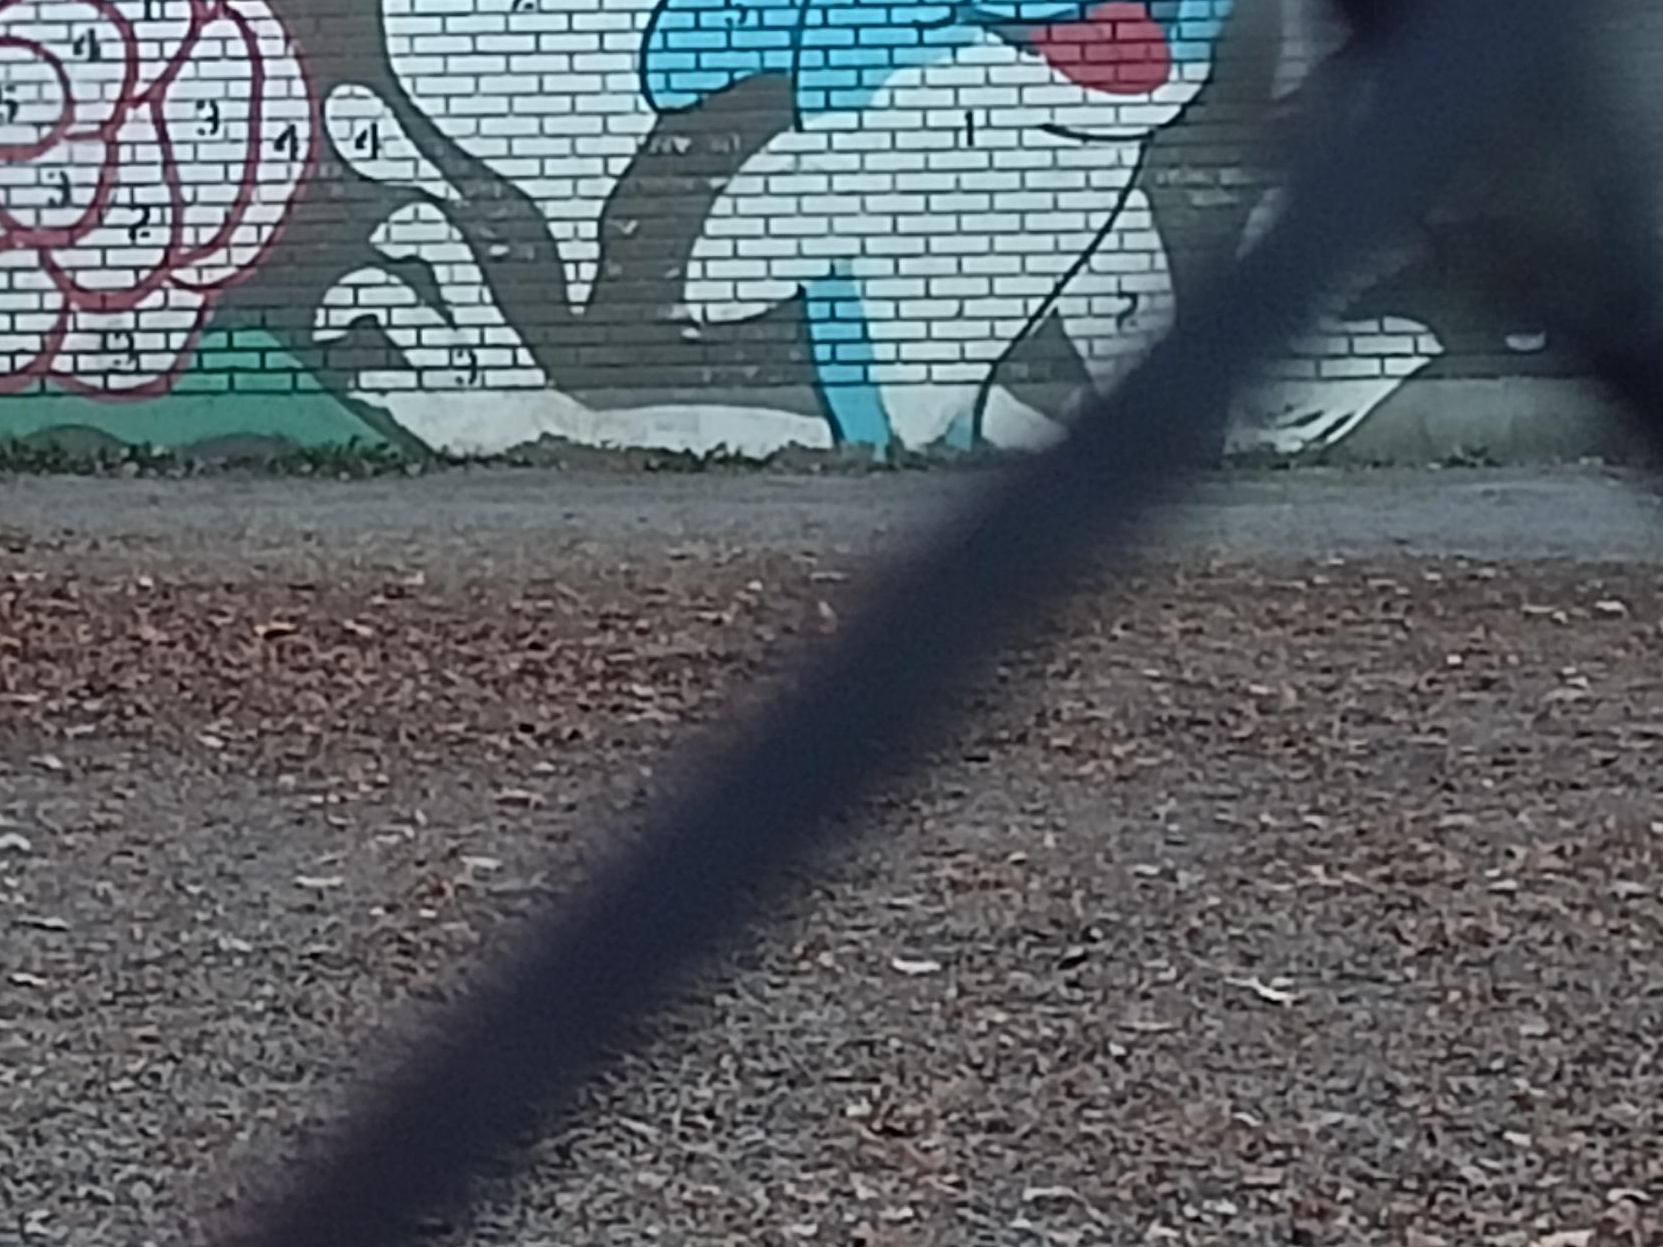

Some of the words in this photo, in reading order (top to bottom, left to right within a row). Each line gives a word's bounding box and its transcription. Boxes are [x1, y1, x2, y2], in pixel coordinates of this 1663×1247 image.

[73, 28, 99, 62] 4
[196, 99, 219, 136] 3
[965, 111, 975, 147] 1
[274, 124, 299, 163] 4
[355, 121, 379, 161] 4
